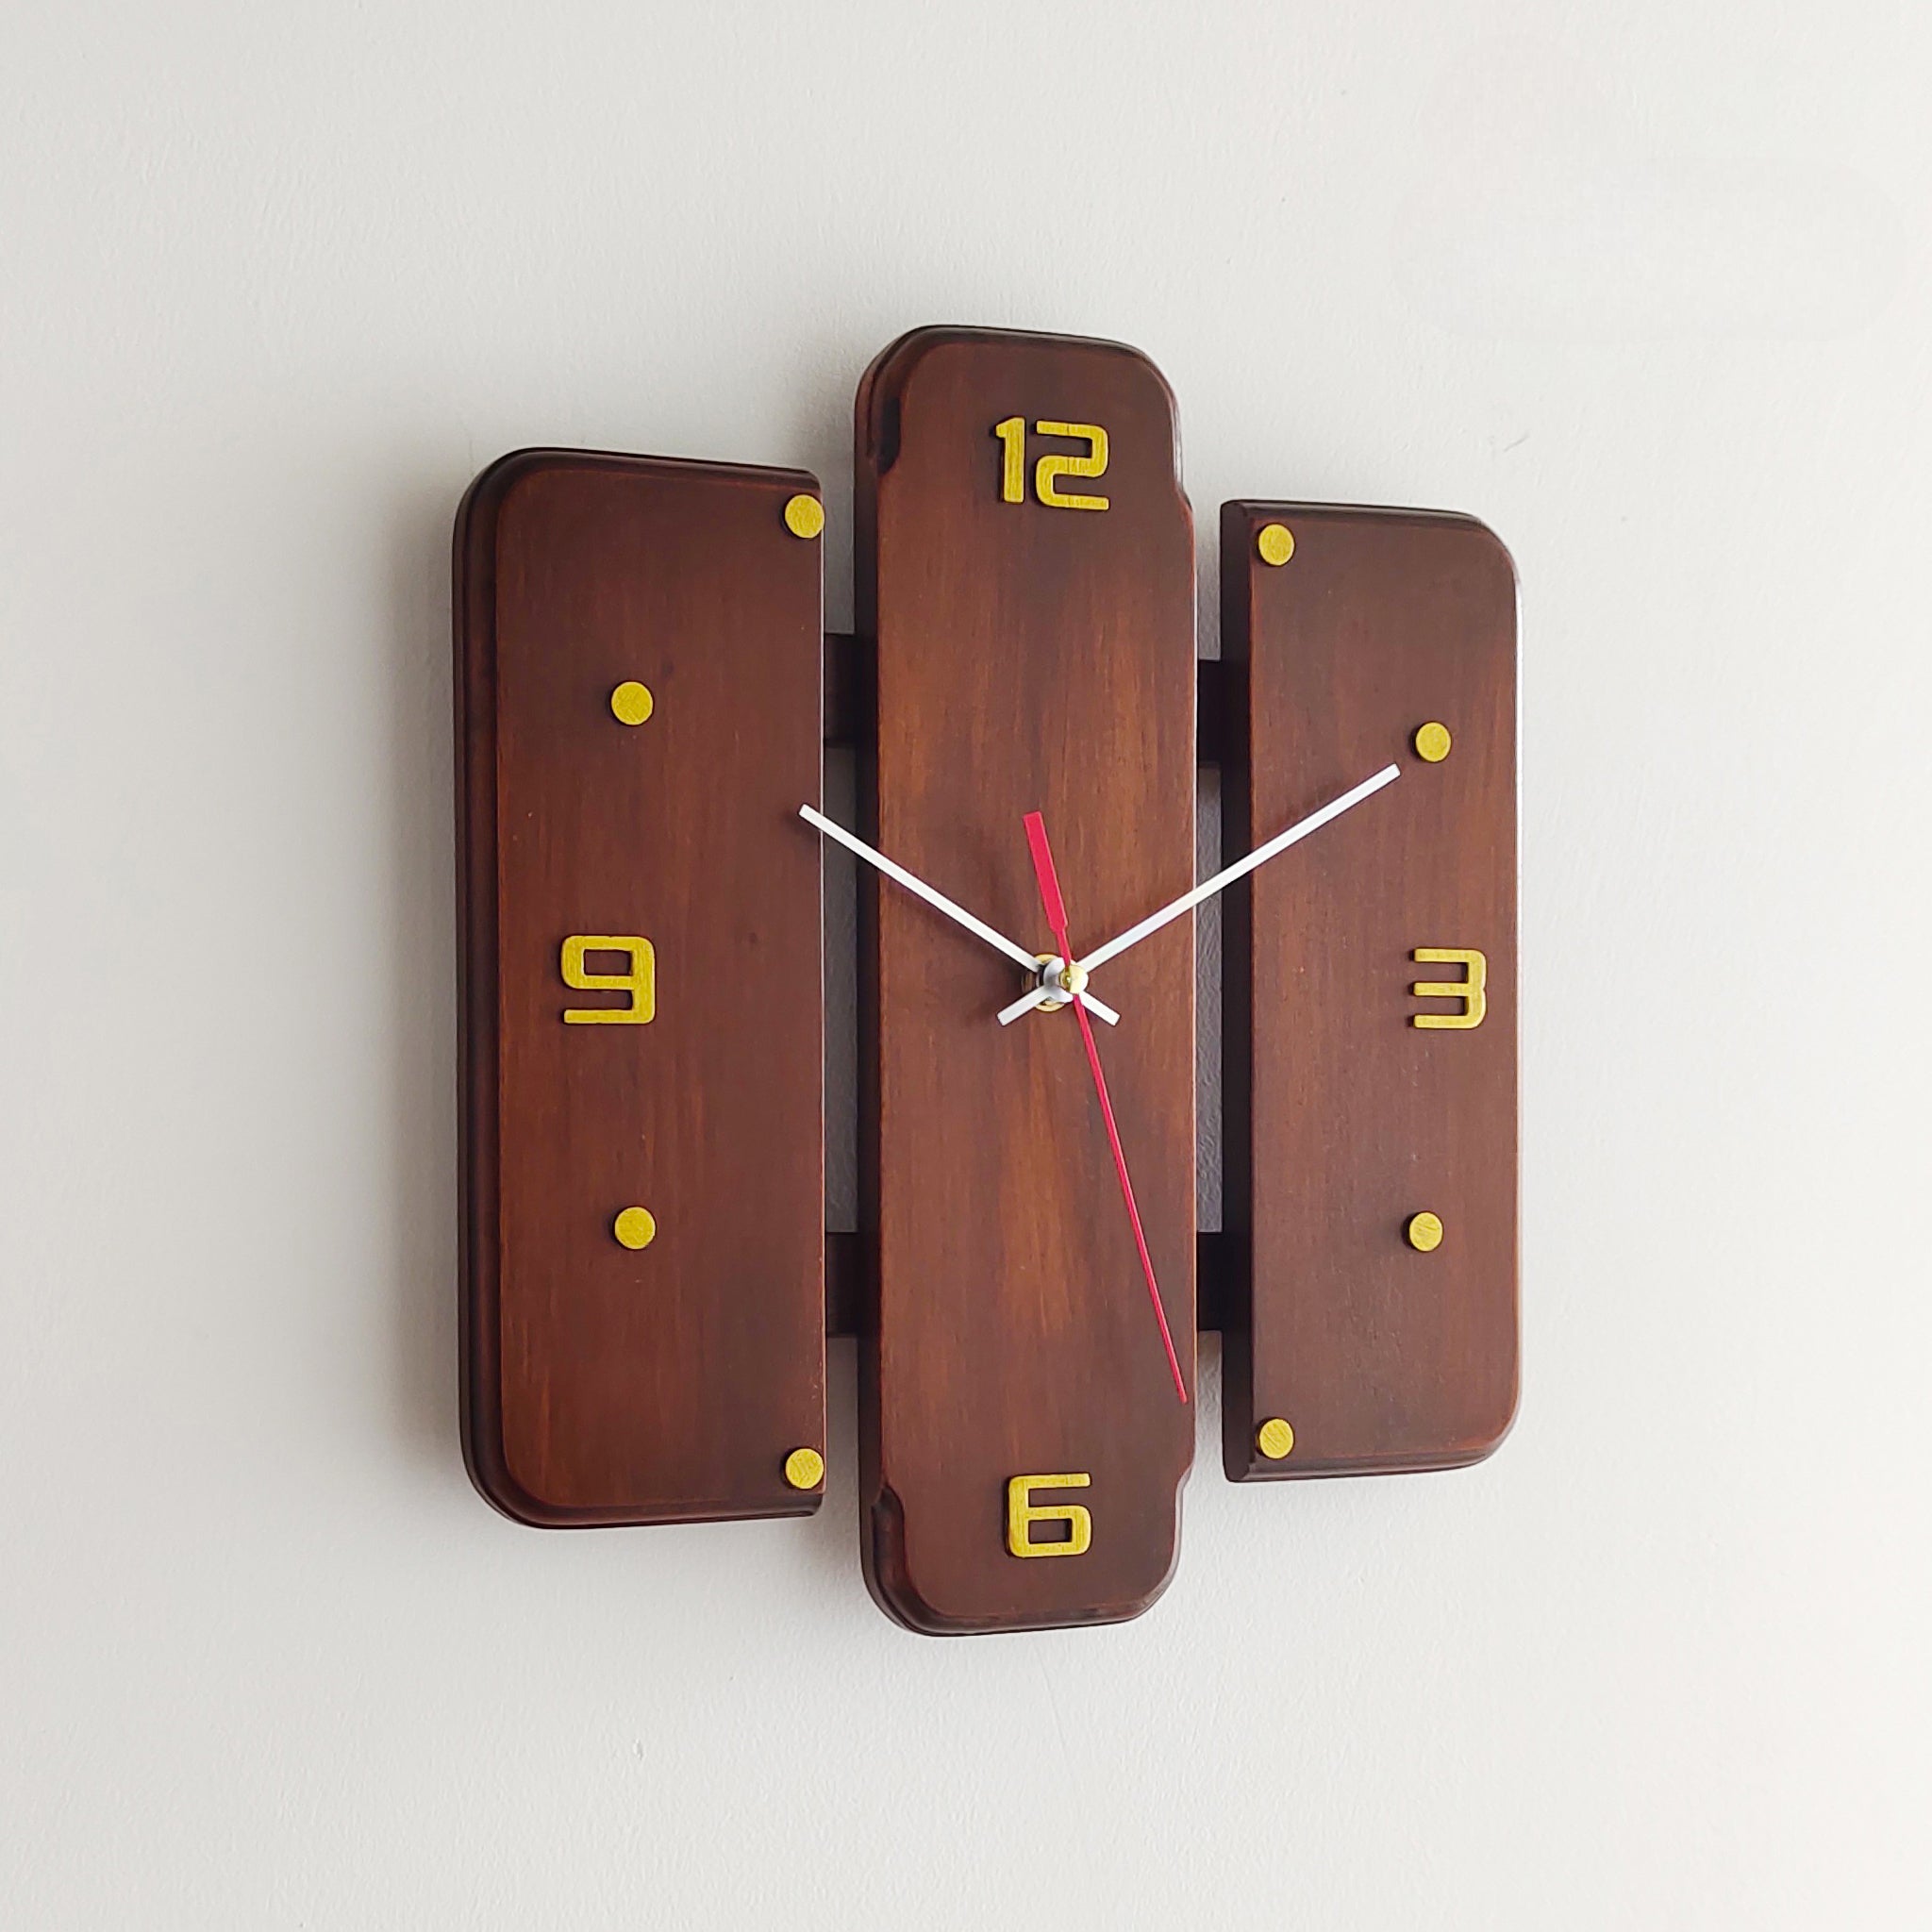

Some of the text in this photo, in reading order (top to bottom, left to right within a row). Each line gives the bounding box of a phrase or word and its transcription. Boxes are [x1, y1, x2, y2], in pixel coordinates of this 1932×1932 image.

[995, 416, 1110, 511] 12
[560, 935, 656, 1024] 9
[1413, 948, 1487, 1029] 3
[1008, 1473, 1091, 1558] 6
